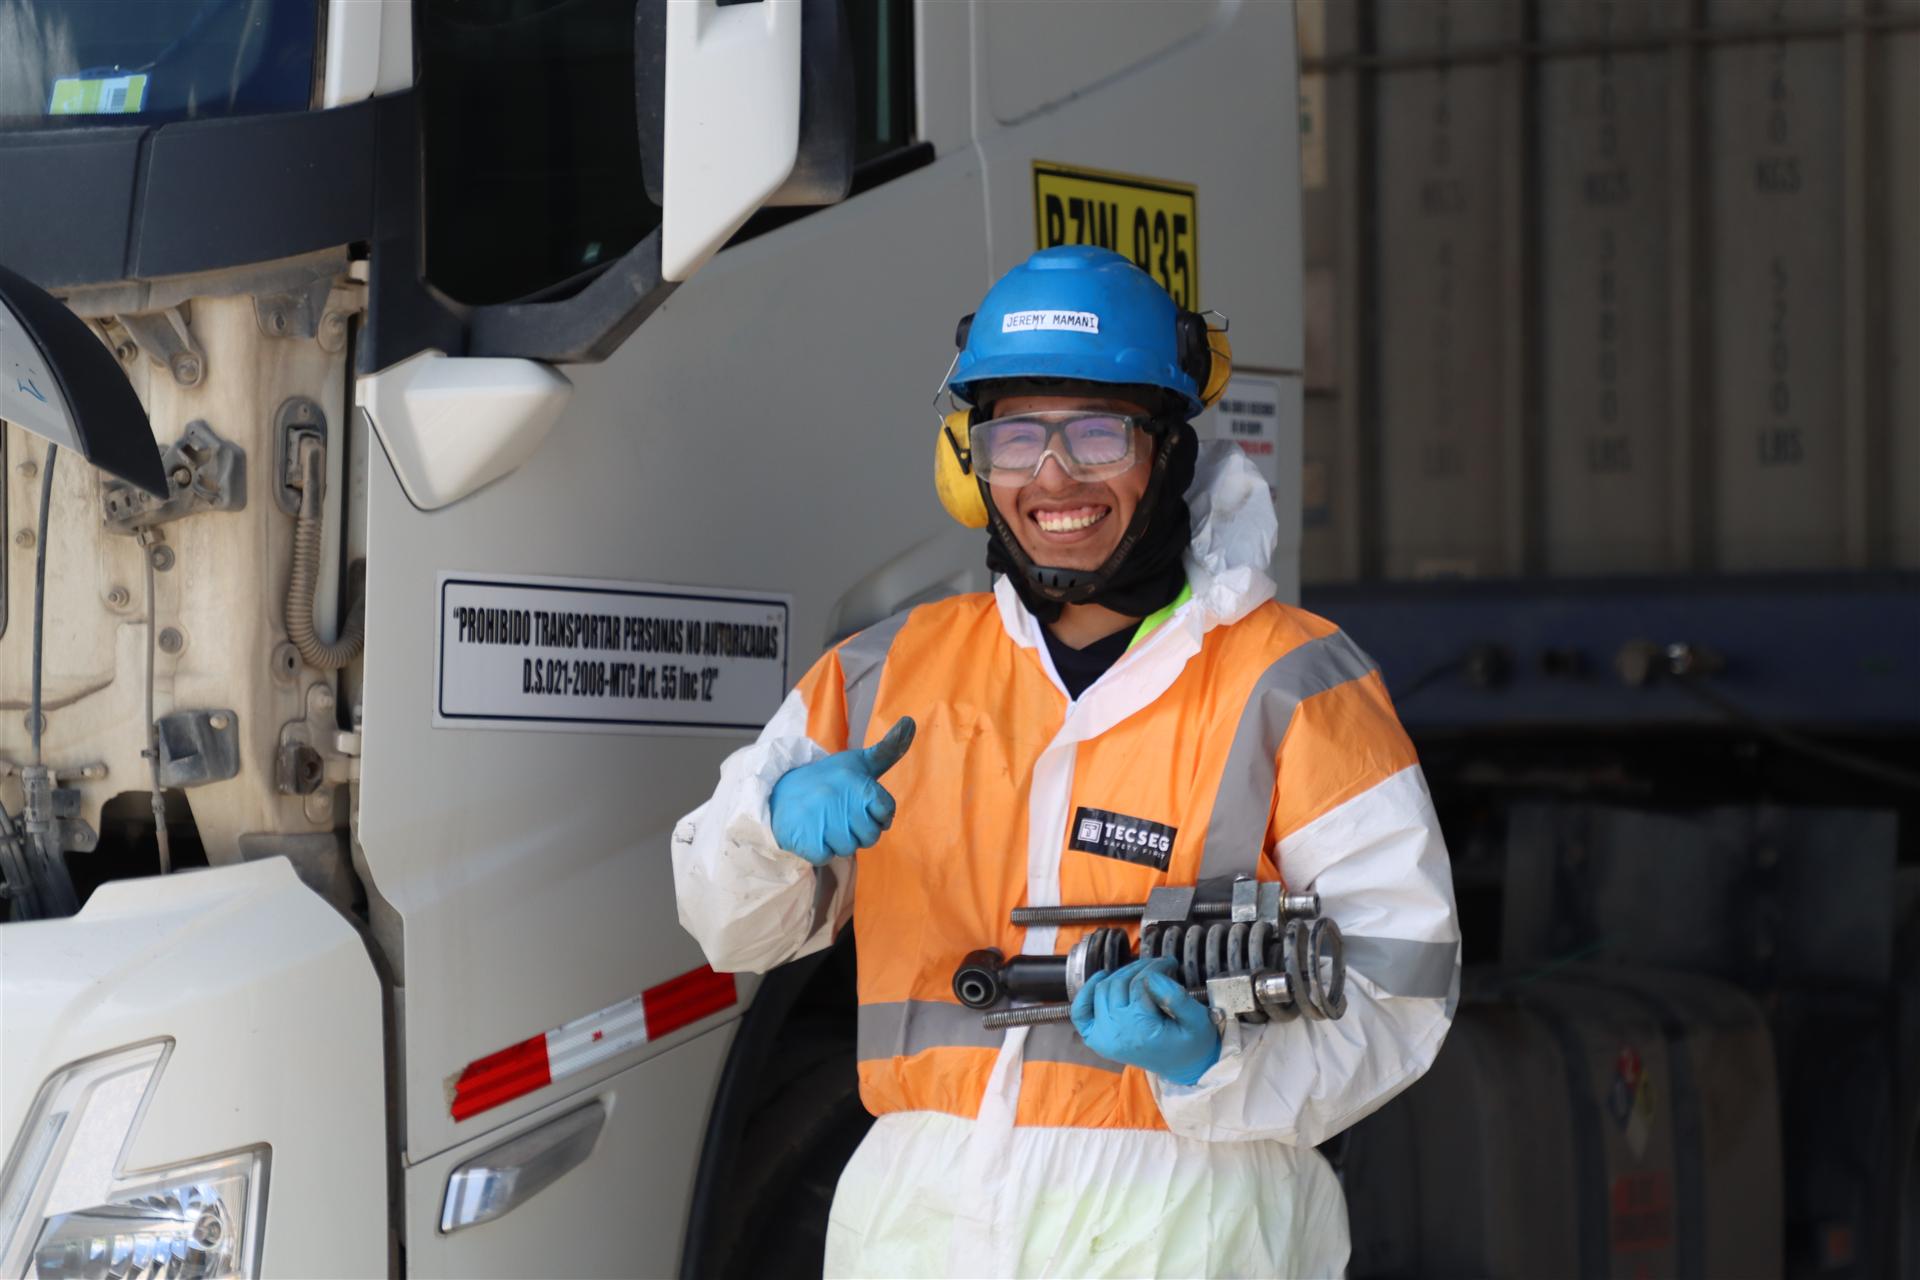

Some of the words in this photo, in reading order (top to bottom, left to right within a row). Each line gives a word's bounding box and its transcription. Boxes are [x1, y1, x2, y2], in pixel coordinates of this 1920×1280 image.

[1007, 314, 1047, 328] JEREMY
[1052, 314, 1096, 328] MAMANI
[534, 610, 621, 651] TRANSPORTAR
[623, 615, 684, 654] PERSONAS
[685, 620, 701, 656] NO
[702, 621, 778, 660] AUTORIZADAS
[637, 663, 658, 699] Art.
[660, 665, 677, 700] 55
[679, 665, 698, 701] Inc
[1105, 823, 1170, 852] TECSEG
